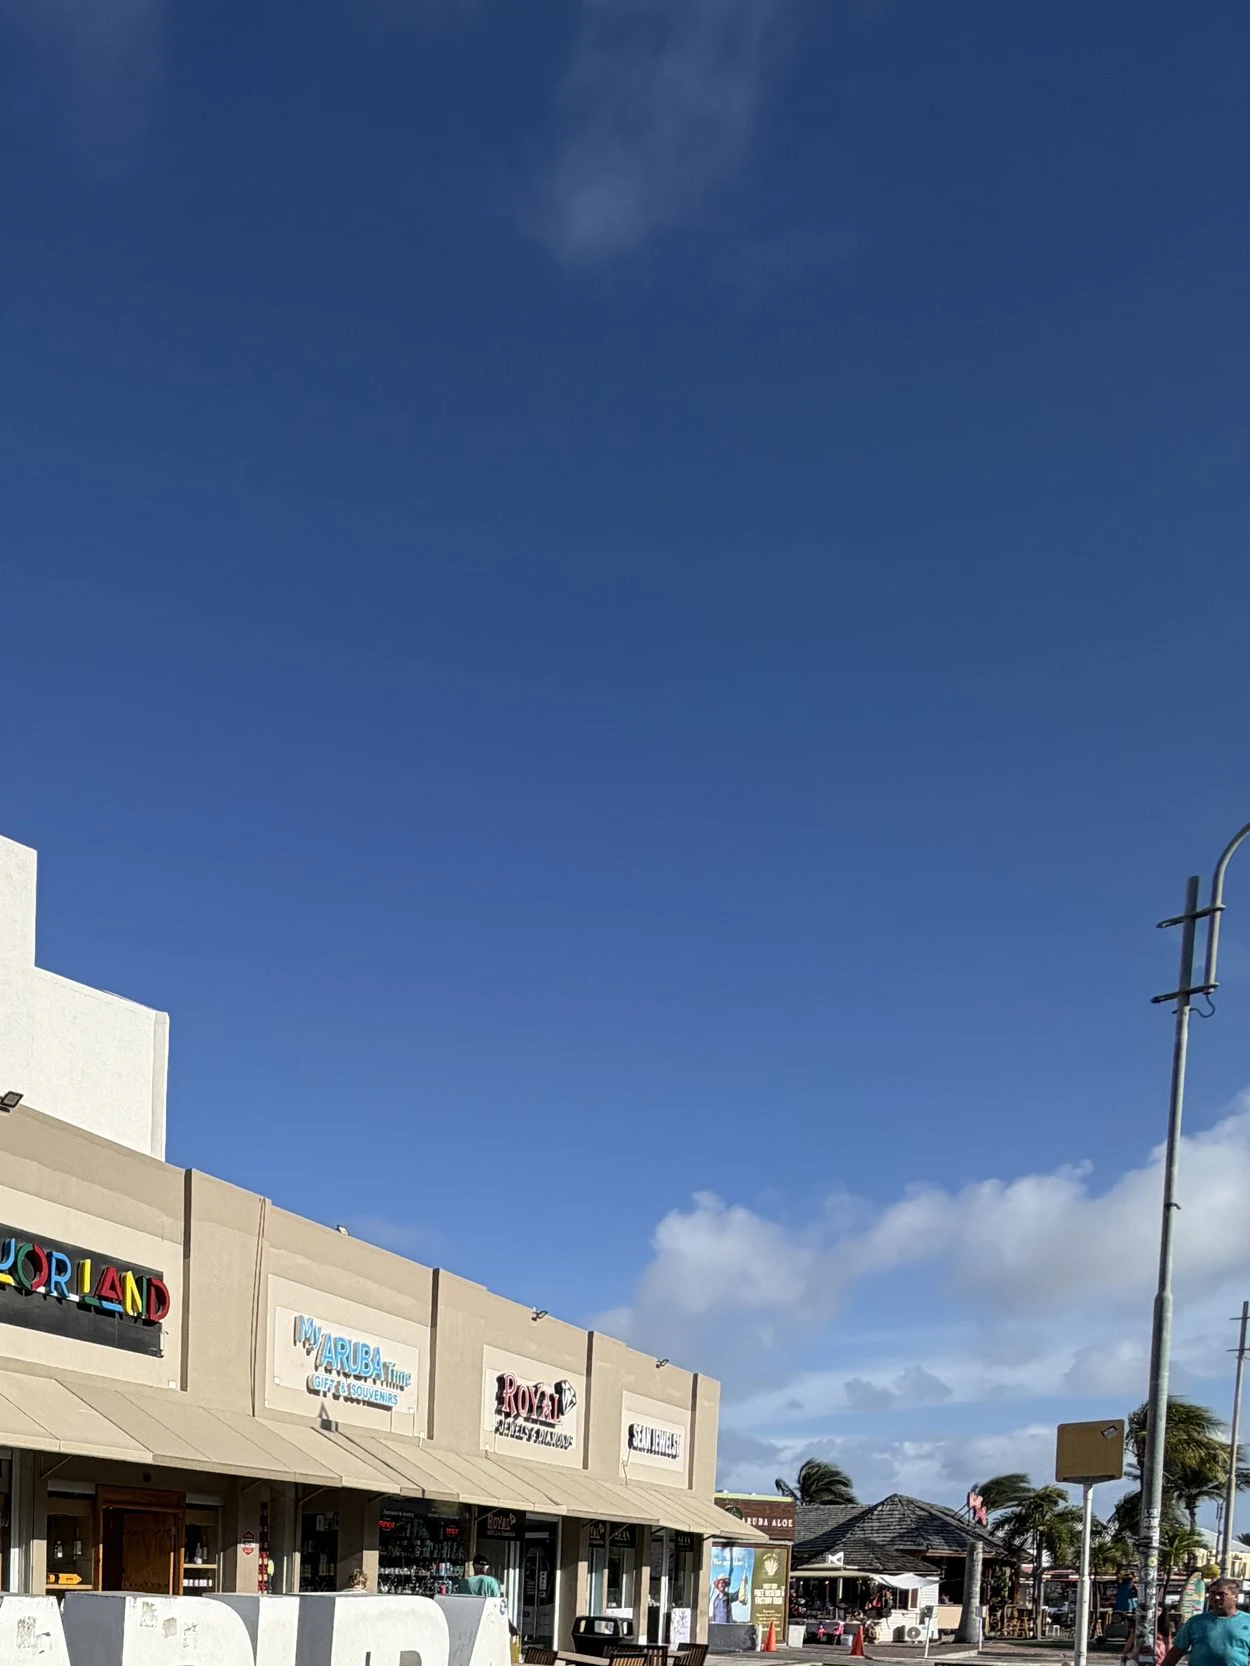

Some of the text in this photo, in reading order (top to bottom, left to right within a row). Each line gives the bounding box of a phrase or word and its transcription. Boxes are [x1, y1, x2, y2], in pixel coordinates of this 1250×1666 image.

[317, 1333, 384, 1381] ARUBA
[312, 1375, 398, 1406] GIFT & SOUVENIRS
[771, 1518, 793, 1527] ALOE
